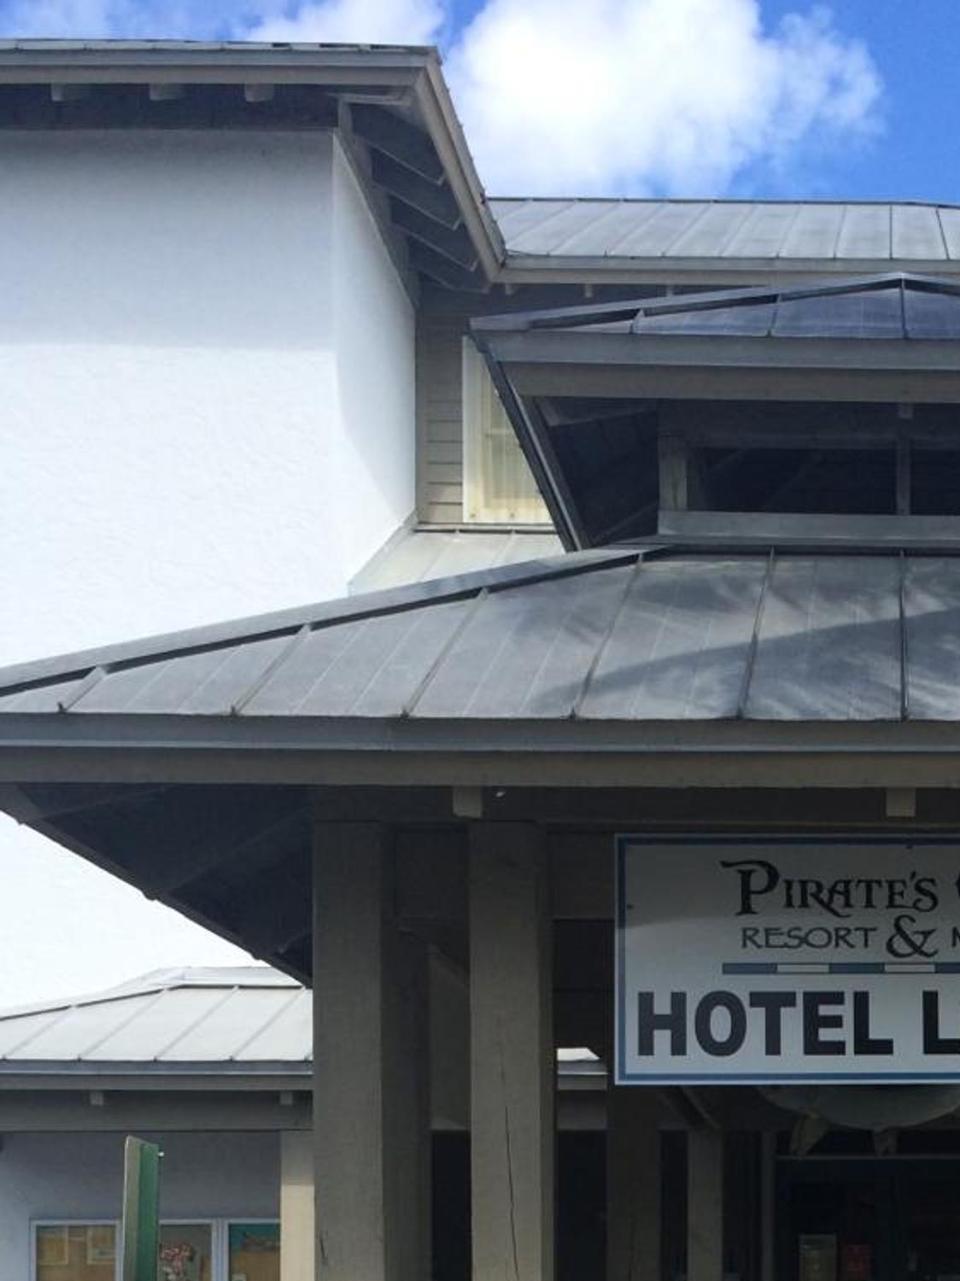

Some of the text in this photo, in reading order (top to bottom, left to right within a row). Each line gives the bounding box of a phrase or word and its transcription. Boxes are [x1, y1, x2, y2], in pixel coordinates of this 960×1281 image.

[720, 859, 938, 918] PIRATE'S
[741, 927, 877, 949] RESORT
[885, 915, 938, 958] &
[637, 990, 894, 1057] HOTEL
